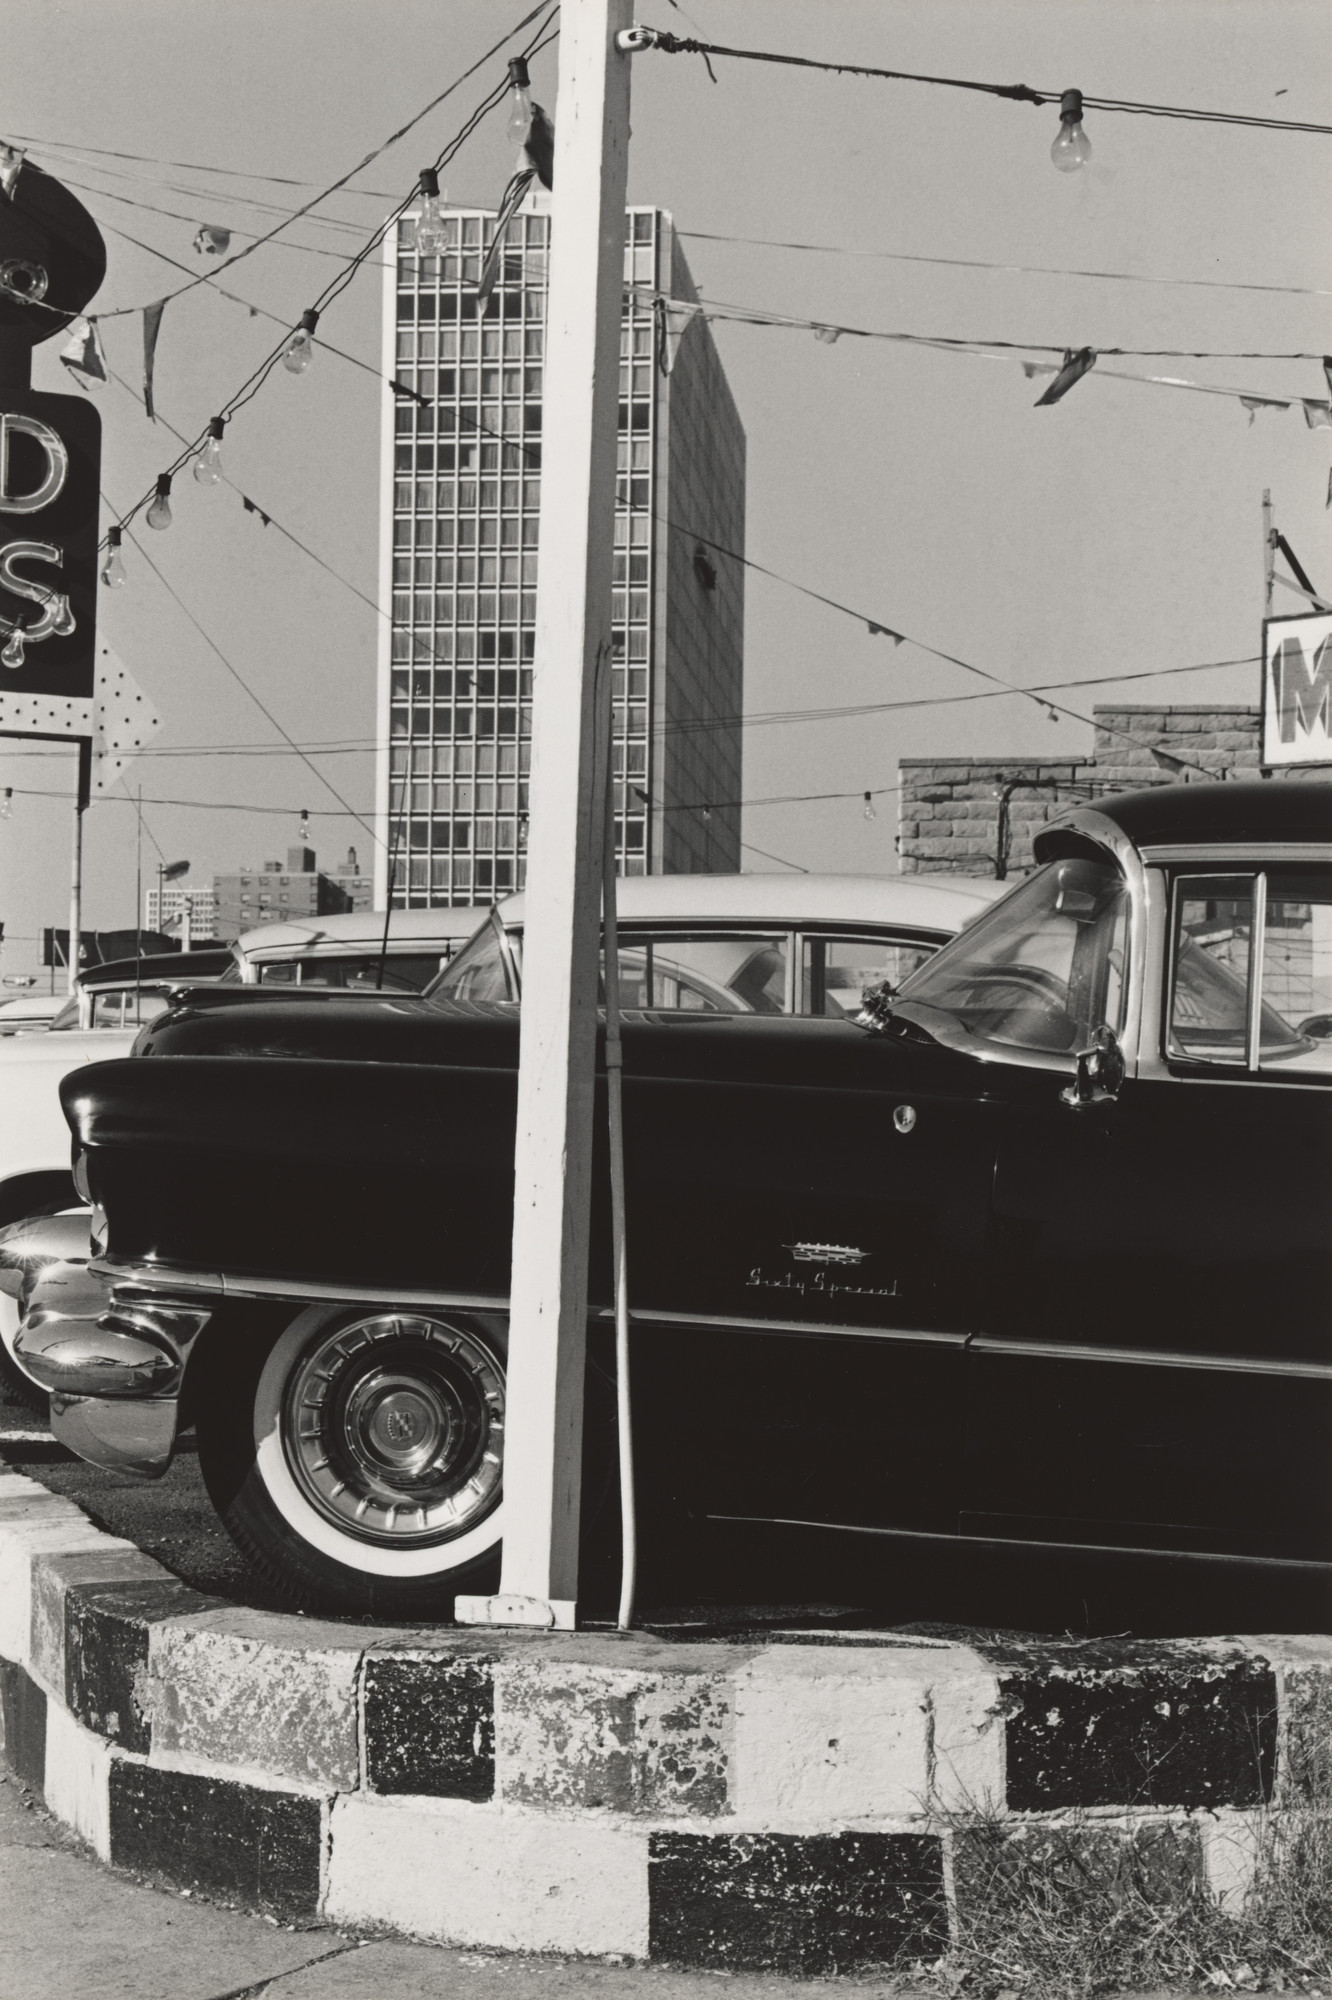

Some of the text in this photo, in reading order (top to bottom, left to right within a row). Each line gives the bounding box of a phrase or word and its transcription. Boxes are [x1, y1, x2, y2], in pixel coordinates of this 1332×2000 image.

[0, 412, 68, 514] D
[0, 538, 64, 642] S
[746, 1267, 805, 1296] Sixty
